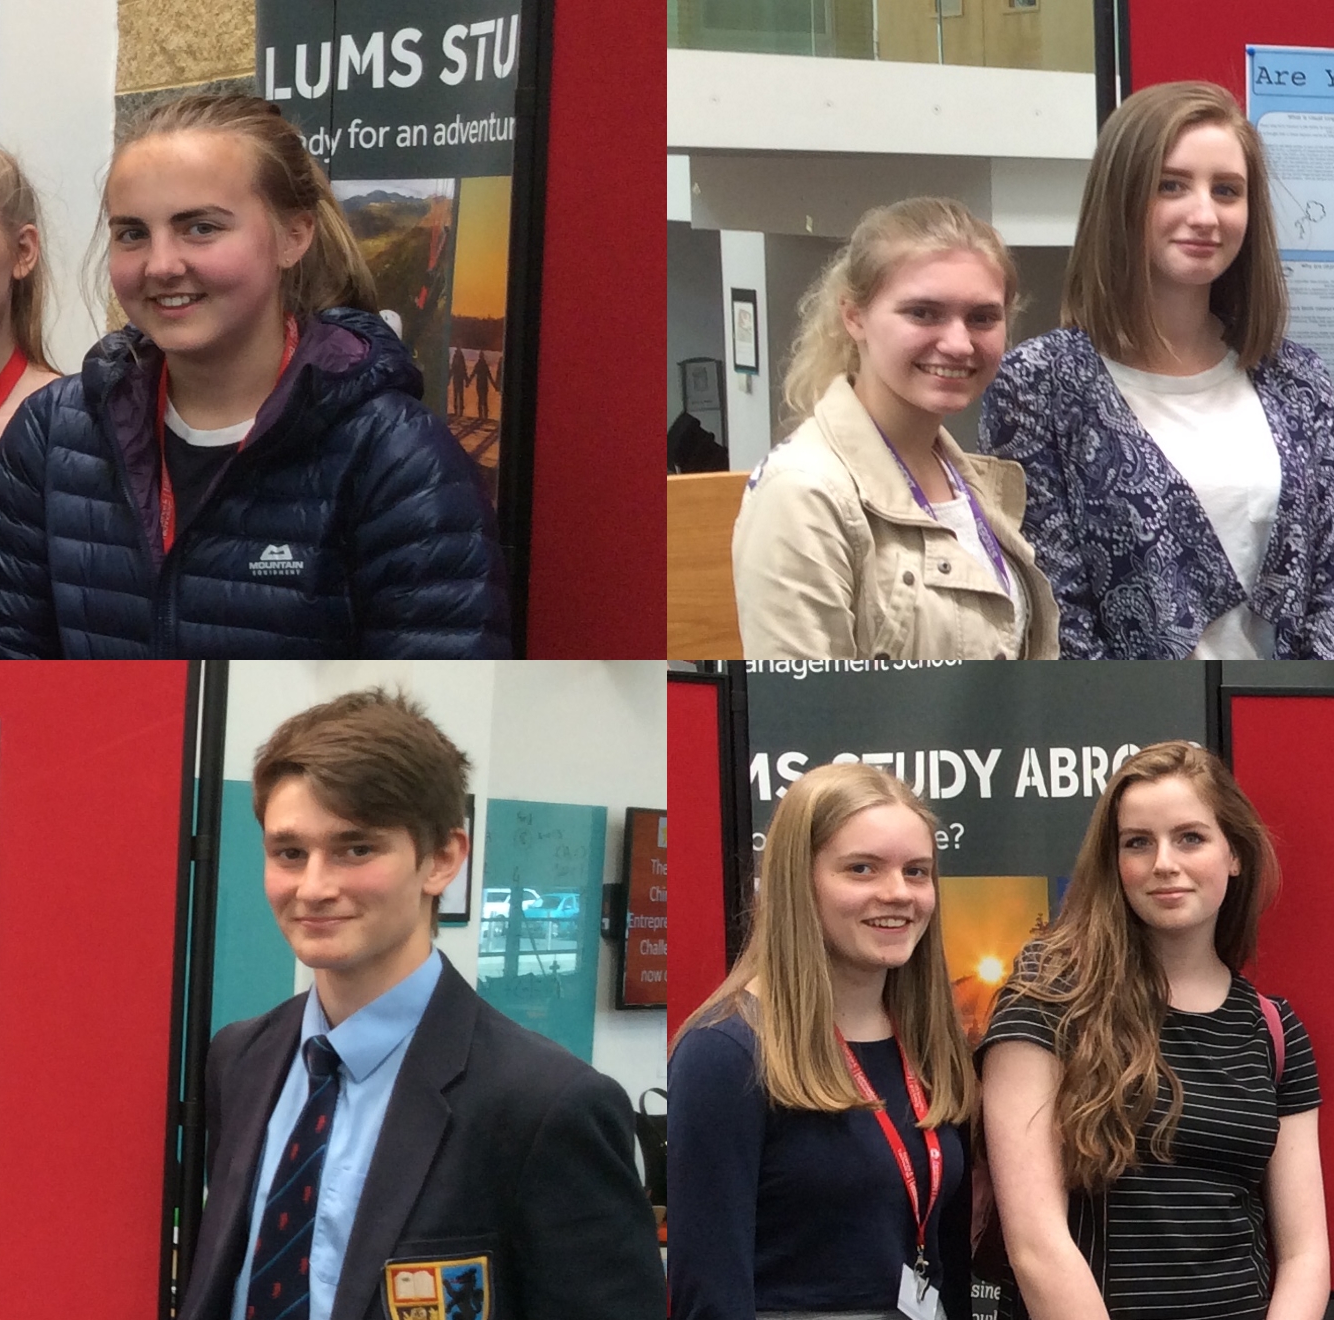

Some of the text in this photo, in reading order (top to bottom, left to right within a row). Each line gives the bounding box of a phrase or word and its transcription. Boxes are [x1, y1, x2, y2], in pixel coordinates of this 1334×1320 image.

[266, 28, 423, 101] LUMS
[1255, 66, 1307, 87] Are
[349, 118, 390, 149] for
[396, 124, 427, 147] an
[249, 561, 304, 570] MOUNTAIN
[641, 969, 663, 982] now
